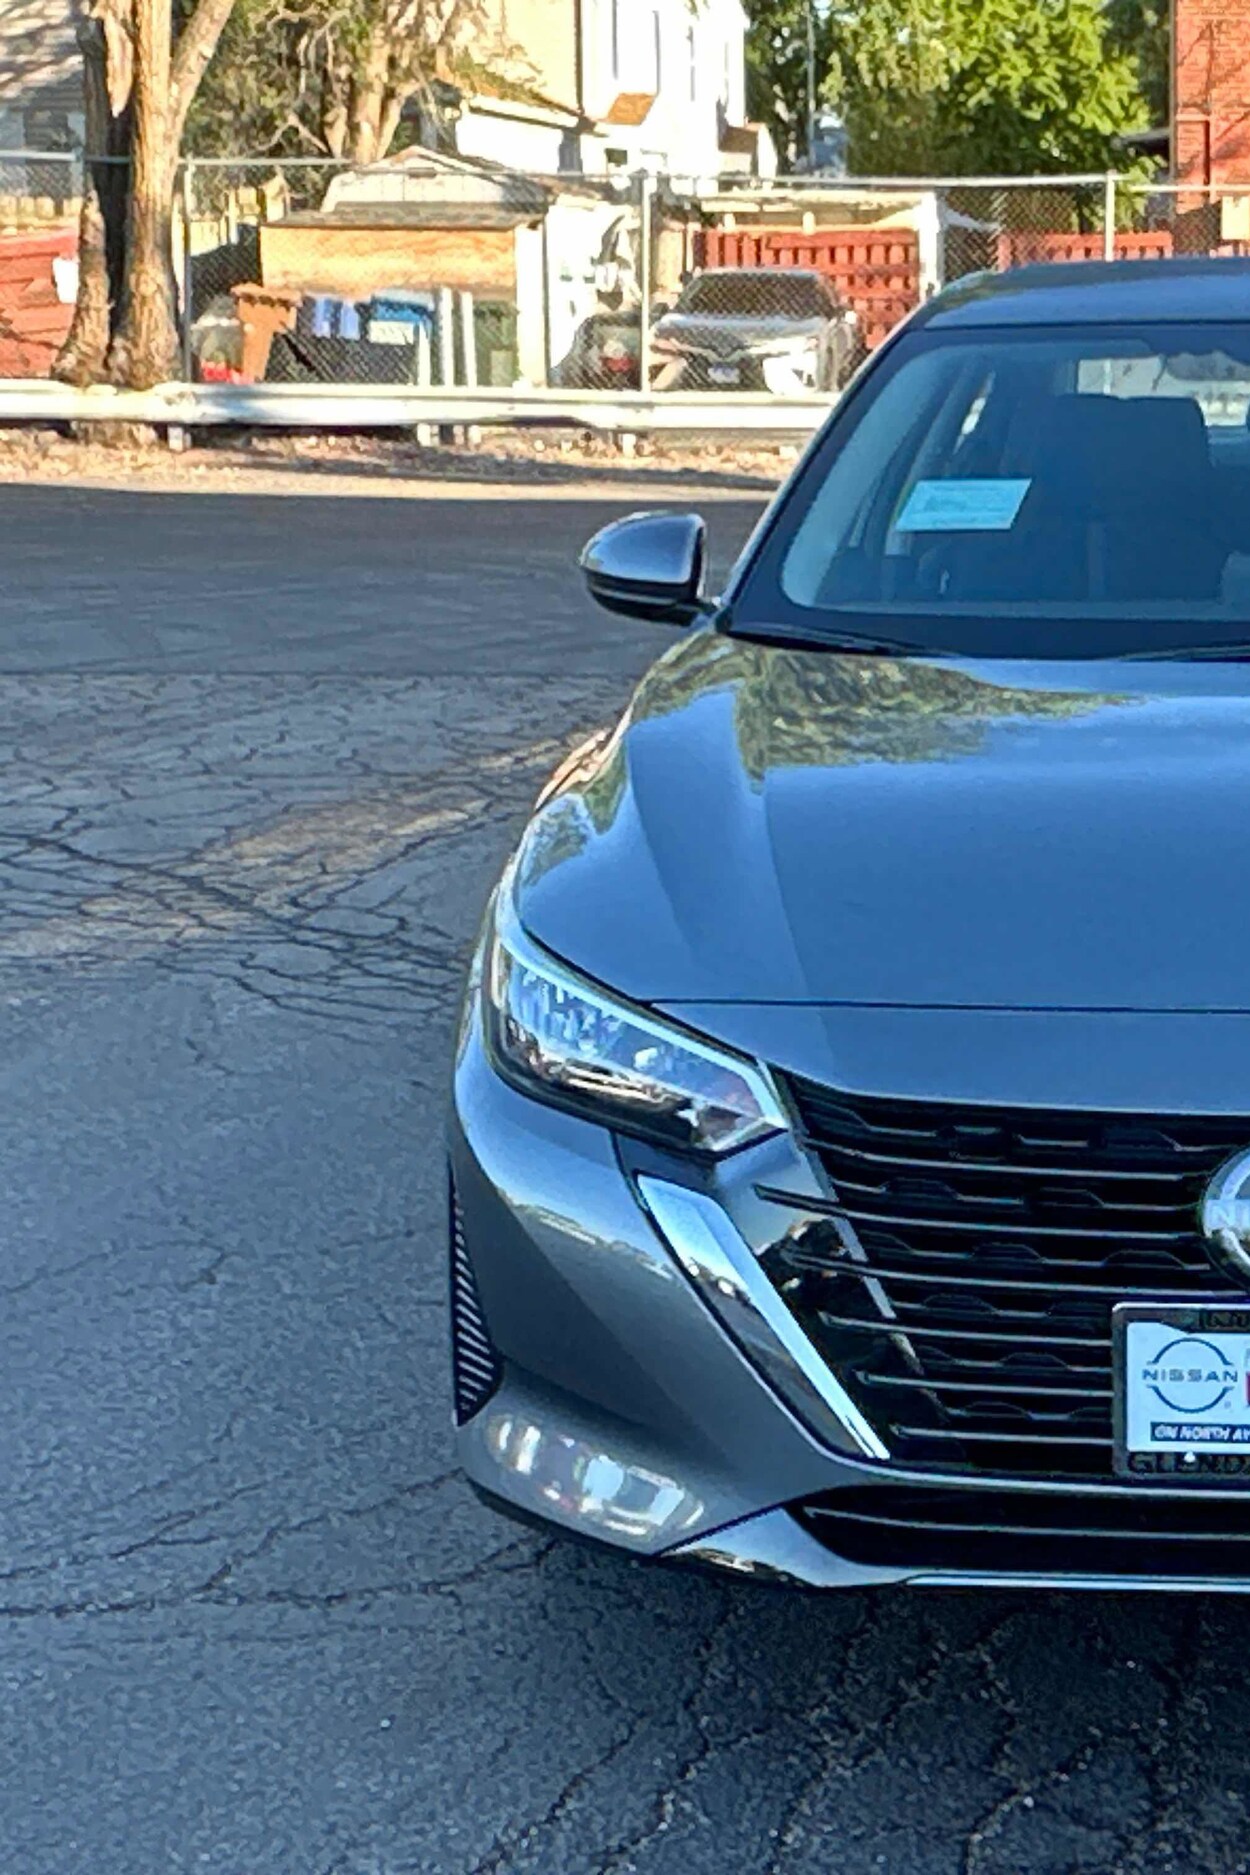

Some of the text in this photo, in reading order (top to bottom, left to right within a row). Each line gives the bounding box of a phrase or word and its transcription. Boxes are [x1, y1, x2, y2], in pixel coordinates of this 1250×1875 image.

[1142, 1367, 1238, 1383] NISSAN
[1154, 1424, 1177, 1440] ON
[1180, 1425, 1230, 1441] NORTH
